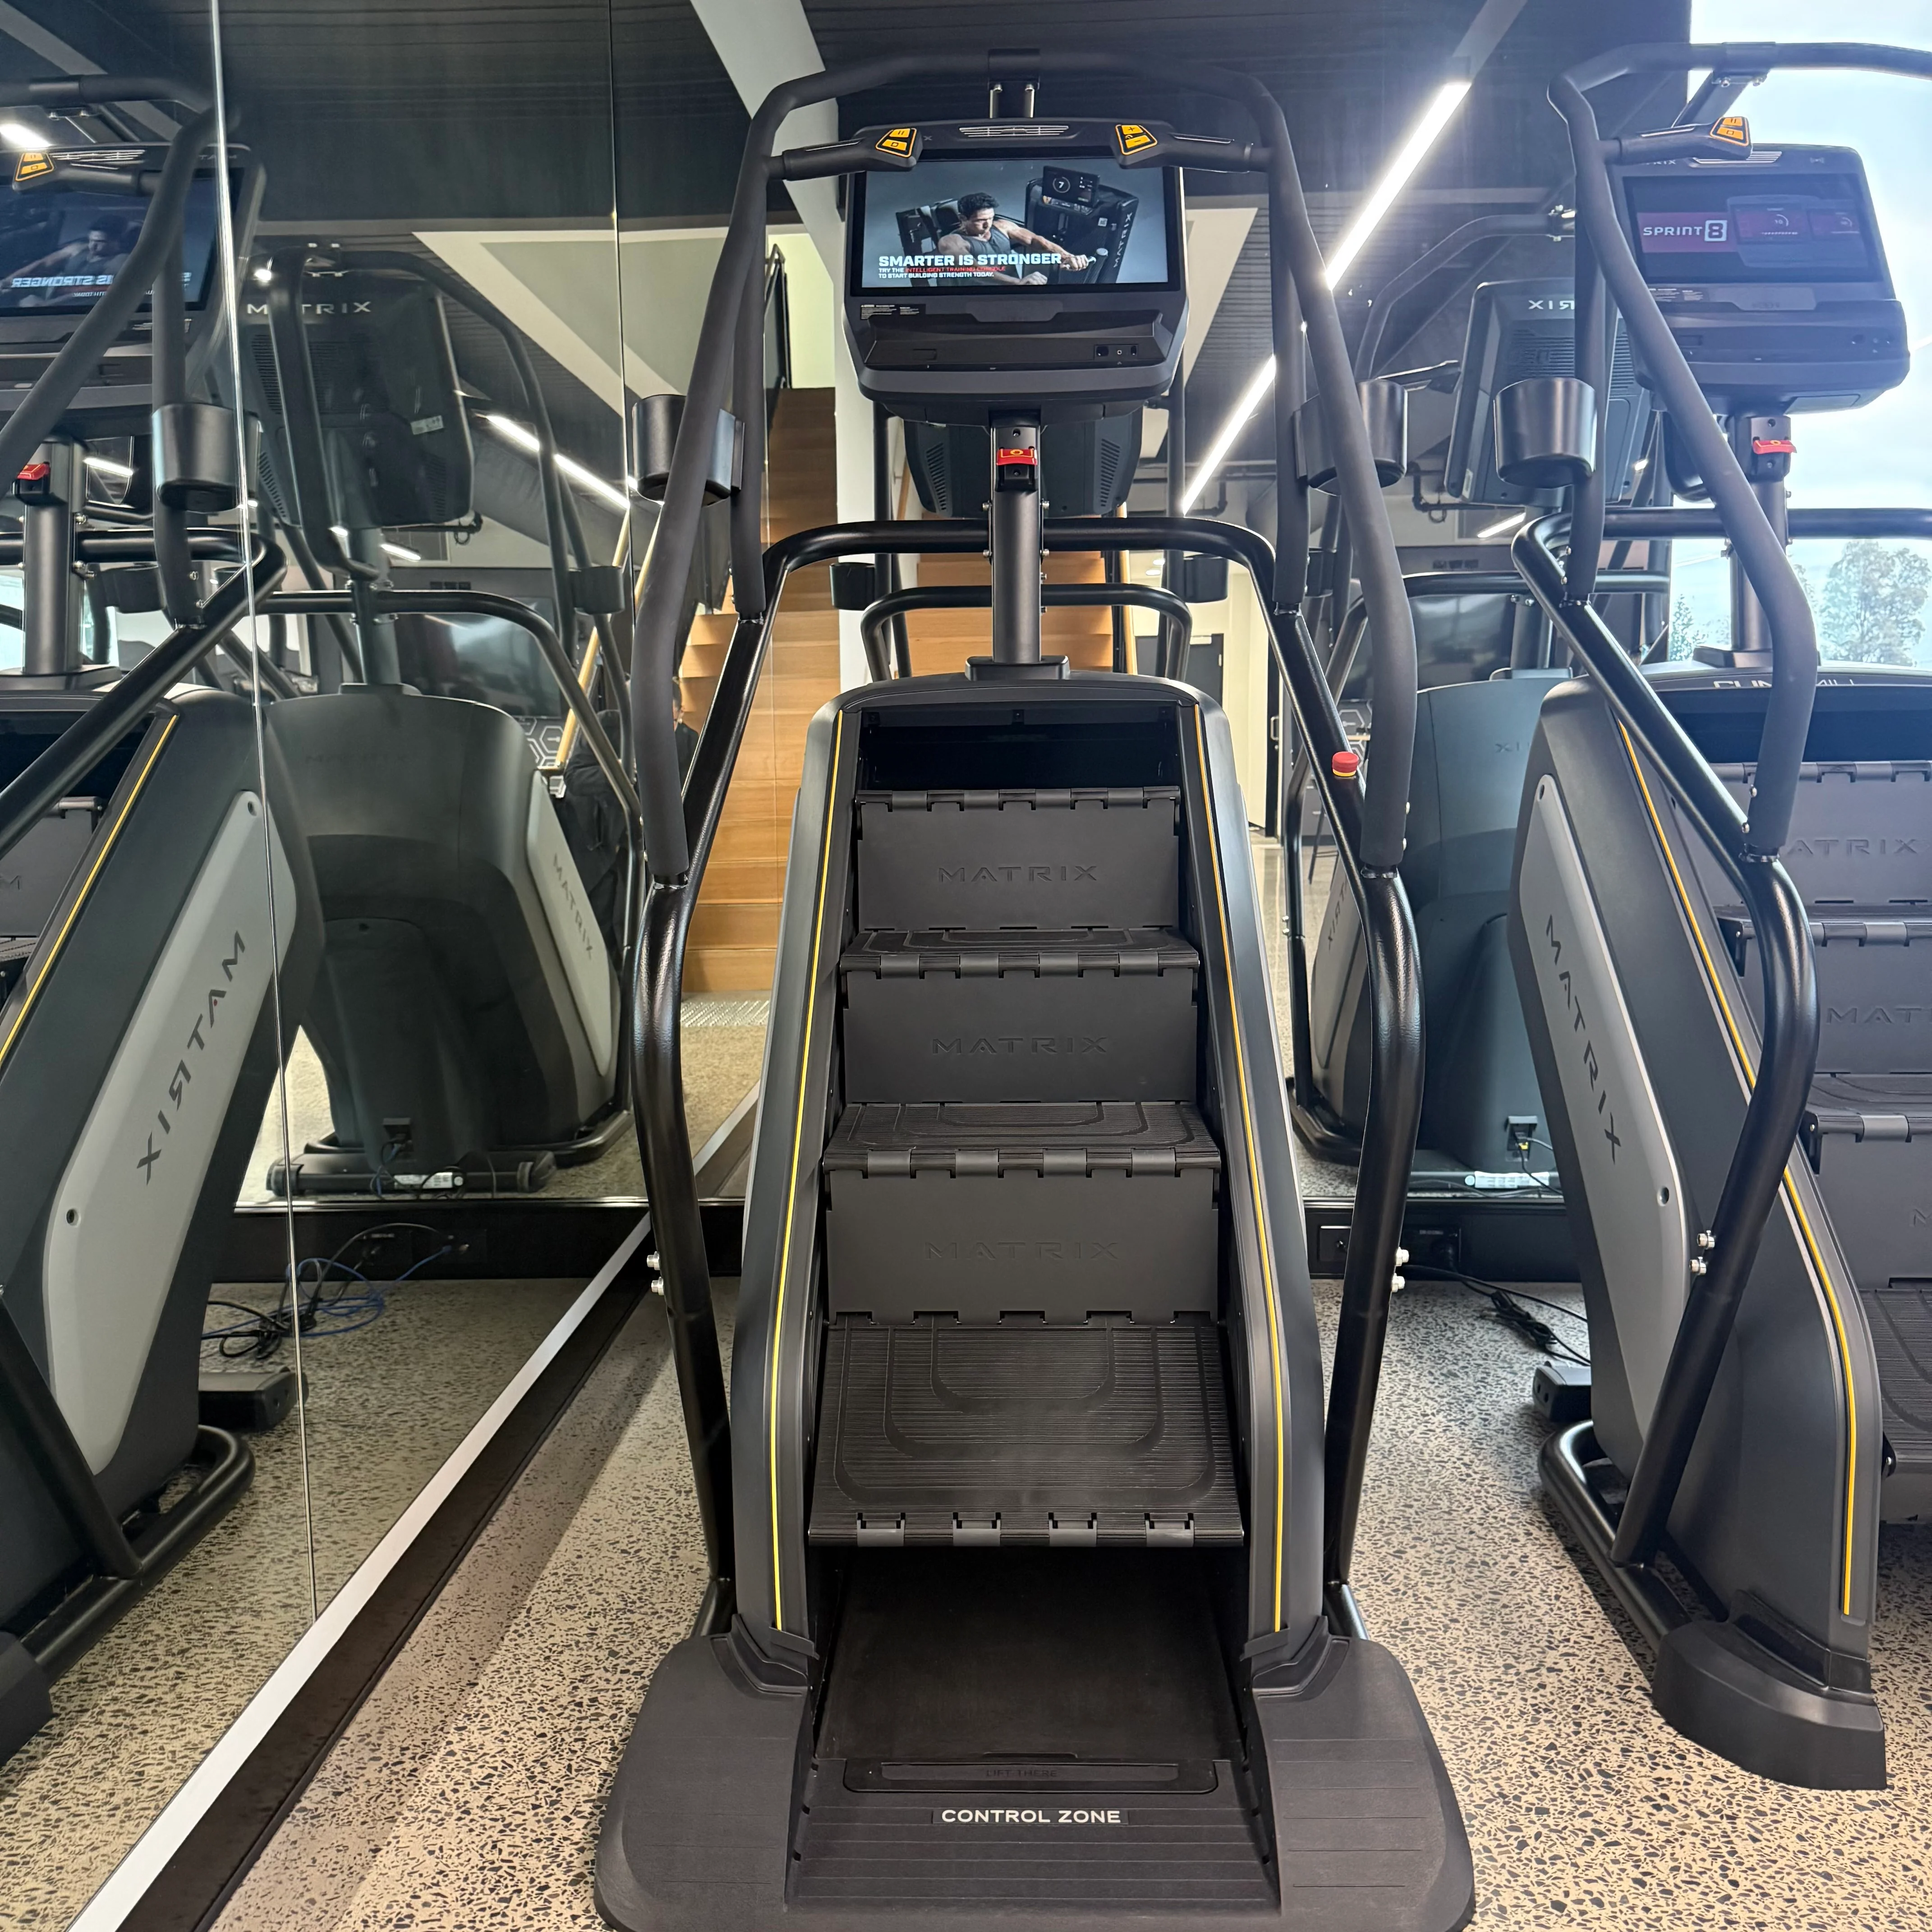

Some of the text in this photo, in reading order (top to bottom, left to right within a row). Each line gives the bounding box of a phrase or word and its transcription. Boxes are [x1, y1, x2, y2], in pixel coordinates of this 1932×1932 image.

[1643, 226, 1703, 235] SPRINT
[879, 253, 1062, 267] SMARTER IS STRONGER
[247, 301, 371, 314] MTRIX
[1786, 839, 1918, 855] ATRIX
[938, 866, 1097, 883] MATRIX
[1826, 1007, 1932, 1023] MAT
[933, 1037, 1108, 1054] MATRIX
[1546, 915, 1621, 1165] MATRIX
[925, 1242, 1119, 1260] MATRIX
[941, 1809, 1121, 1823] CONTROL ZONE
